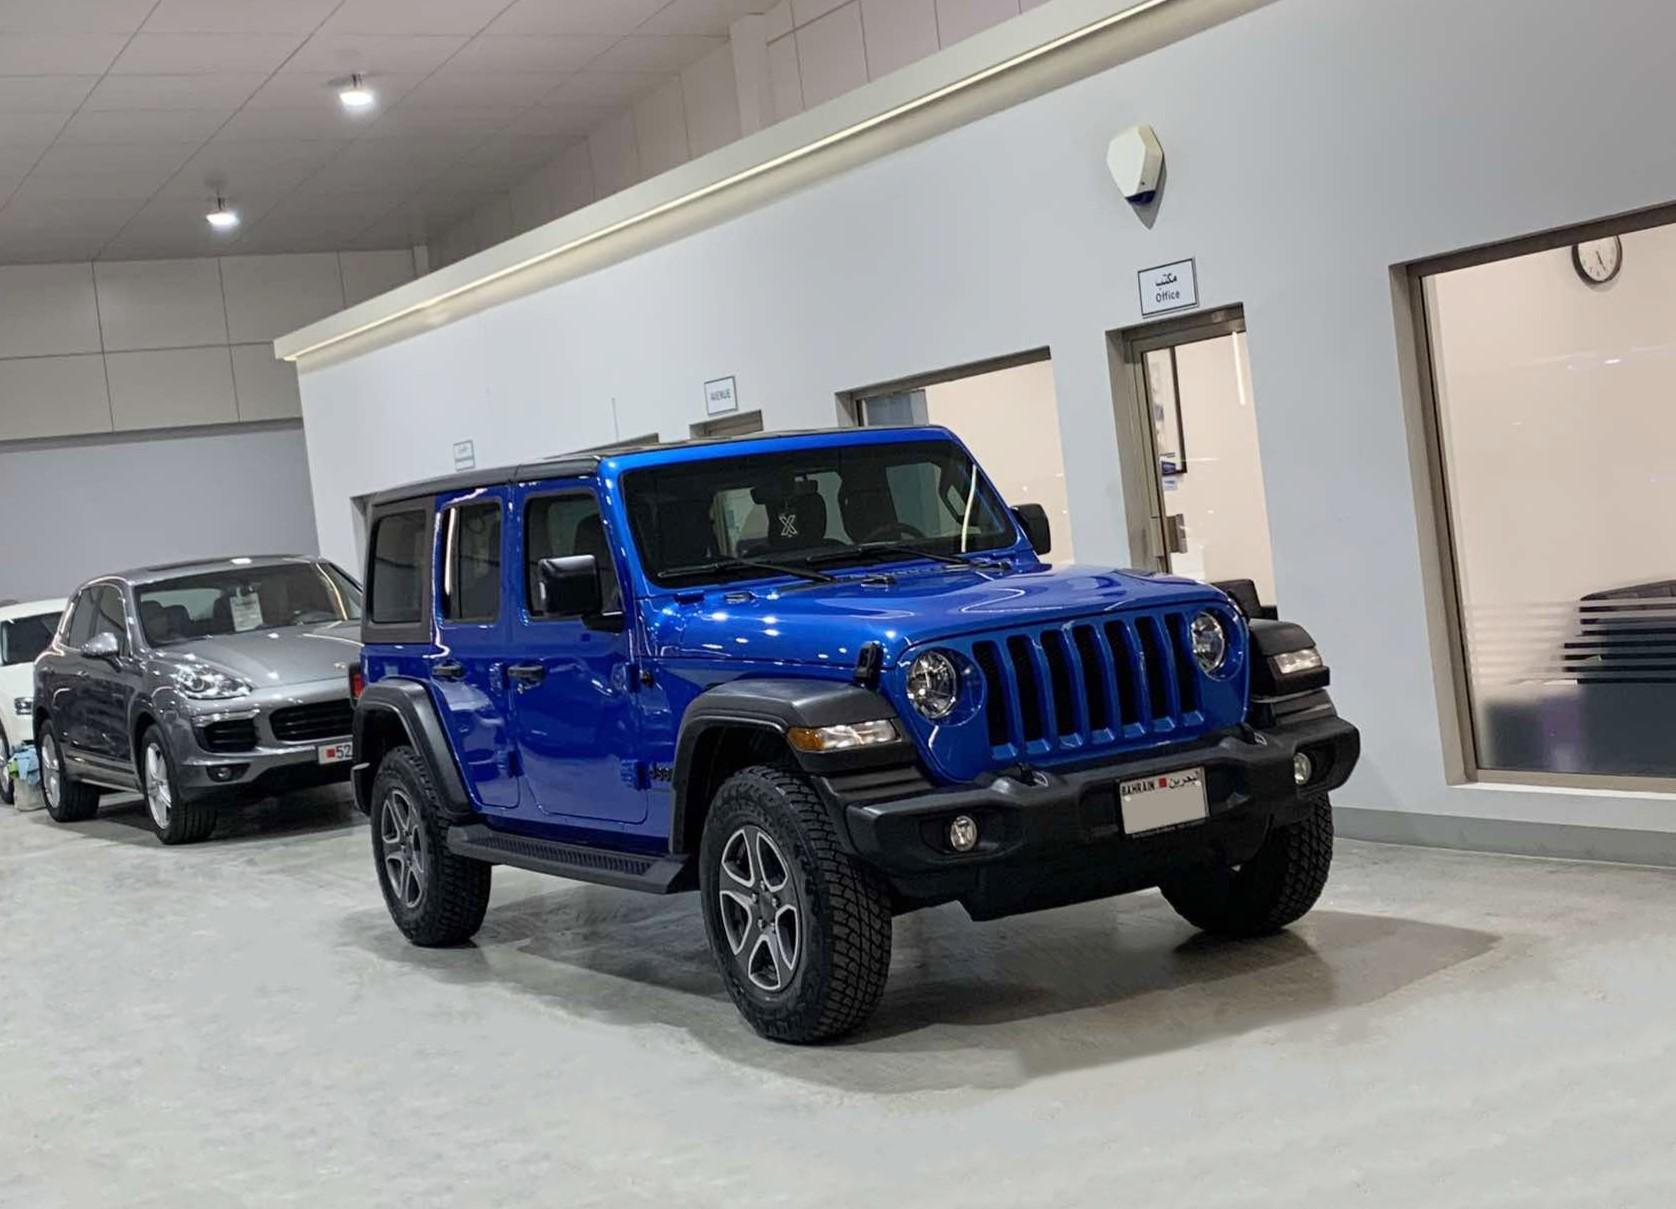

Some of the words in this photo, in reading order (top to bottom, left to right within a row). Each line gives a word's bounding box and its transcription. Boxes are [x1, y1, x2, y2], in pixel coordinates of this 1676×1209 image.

[1155, 272, 1178, 291] مكتب
[1155, 291, 1180, 303] Office
[1121, 780, 1155, 796] BAHRAIN
